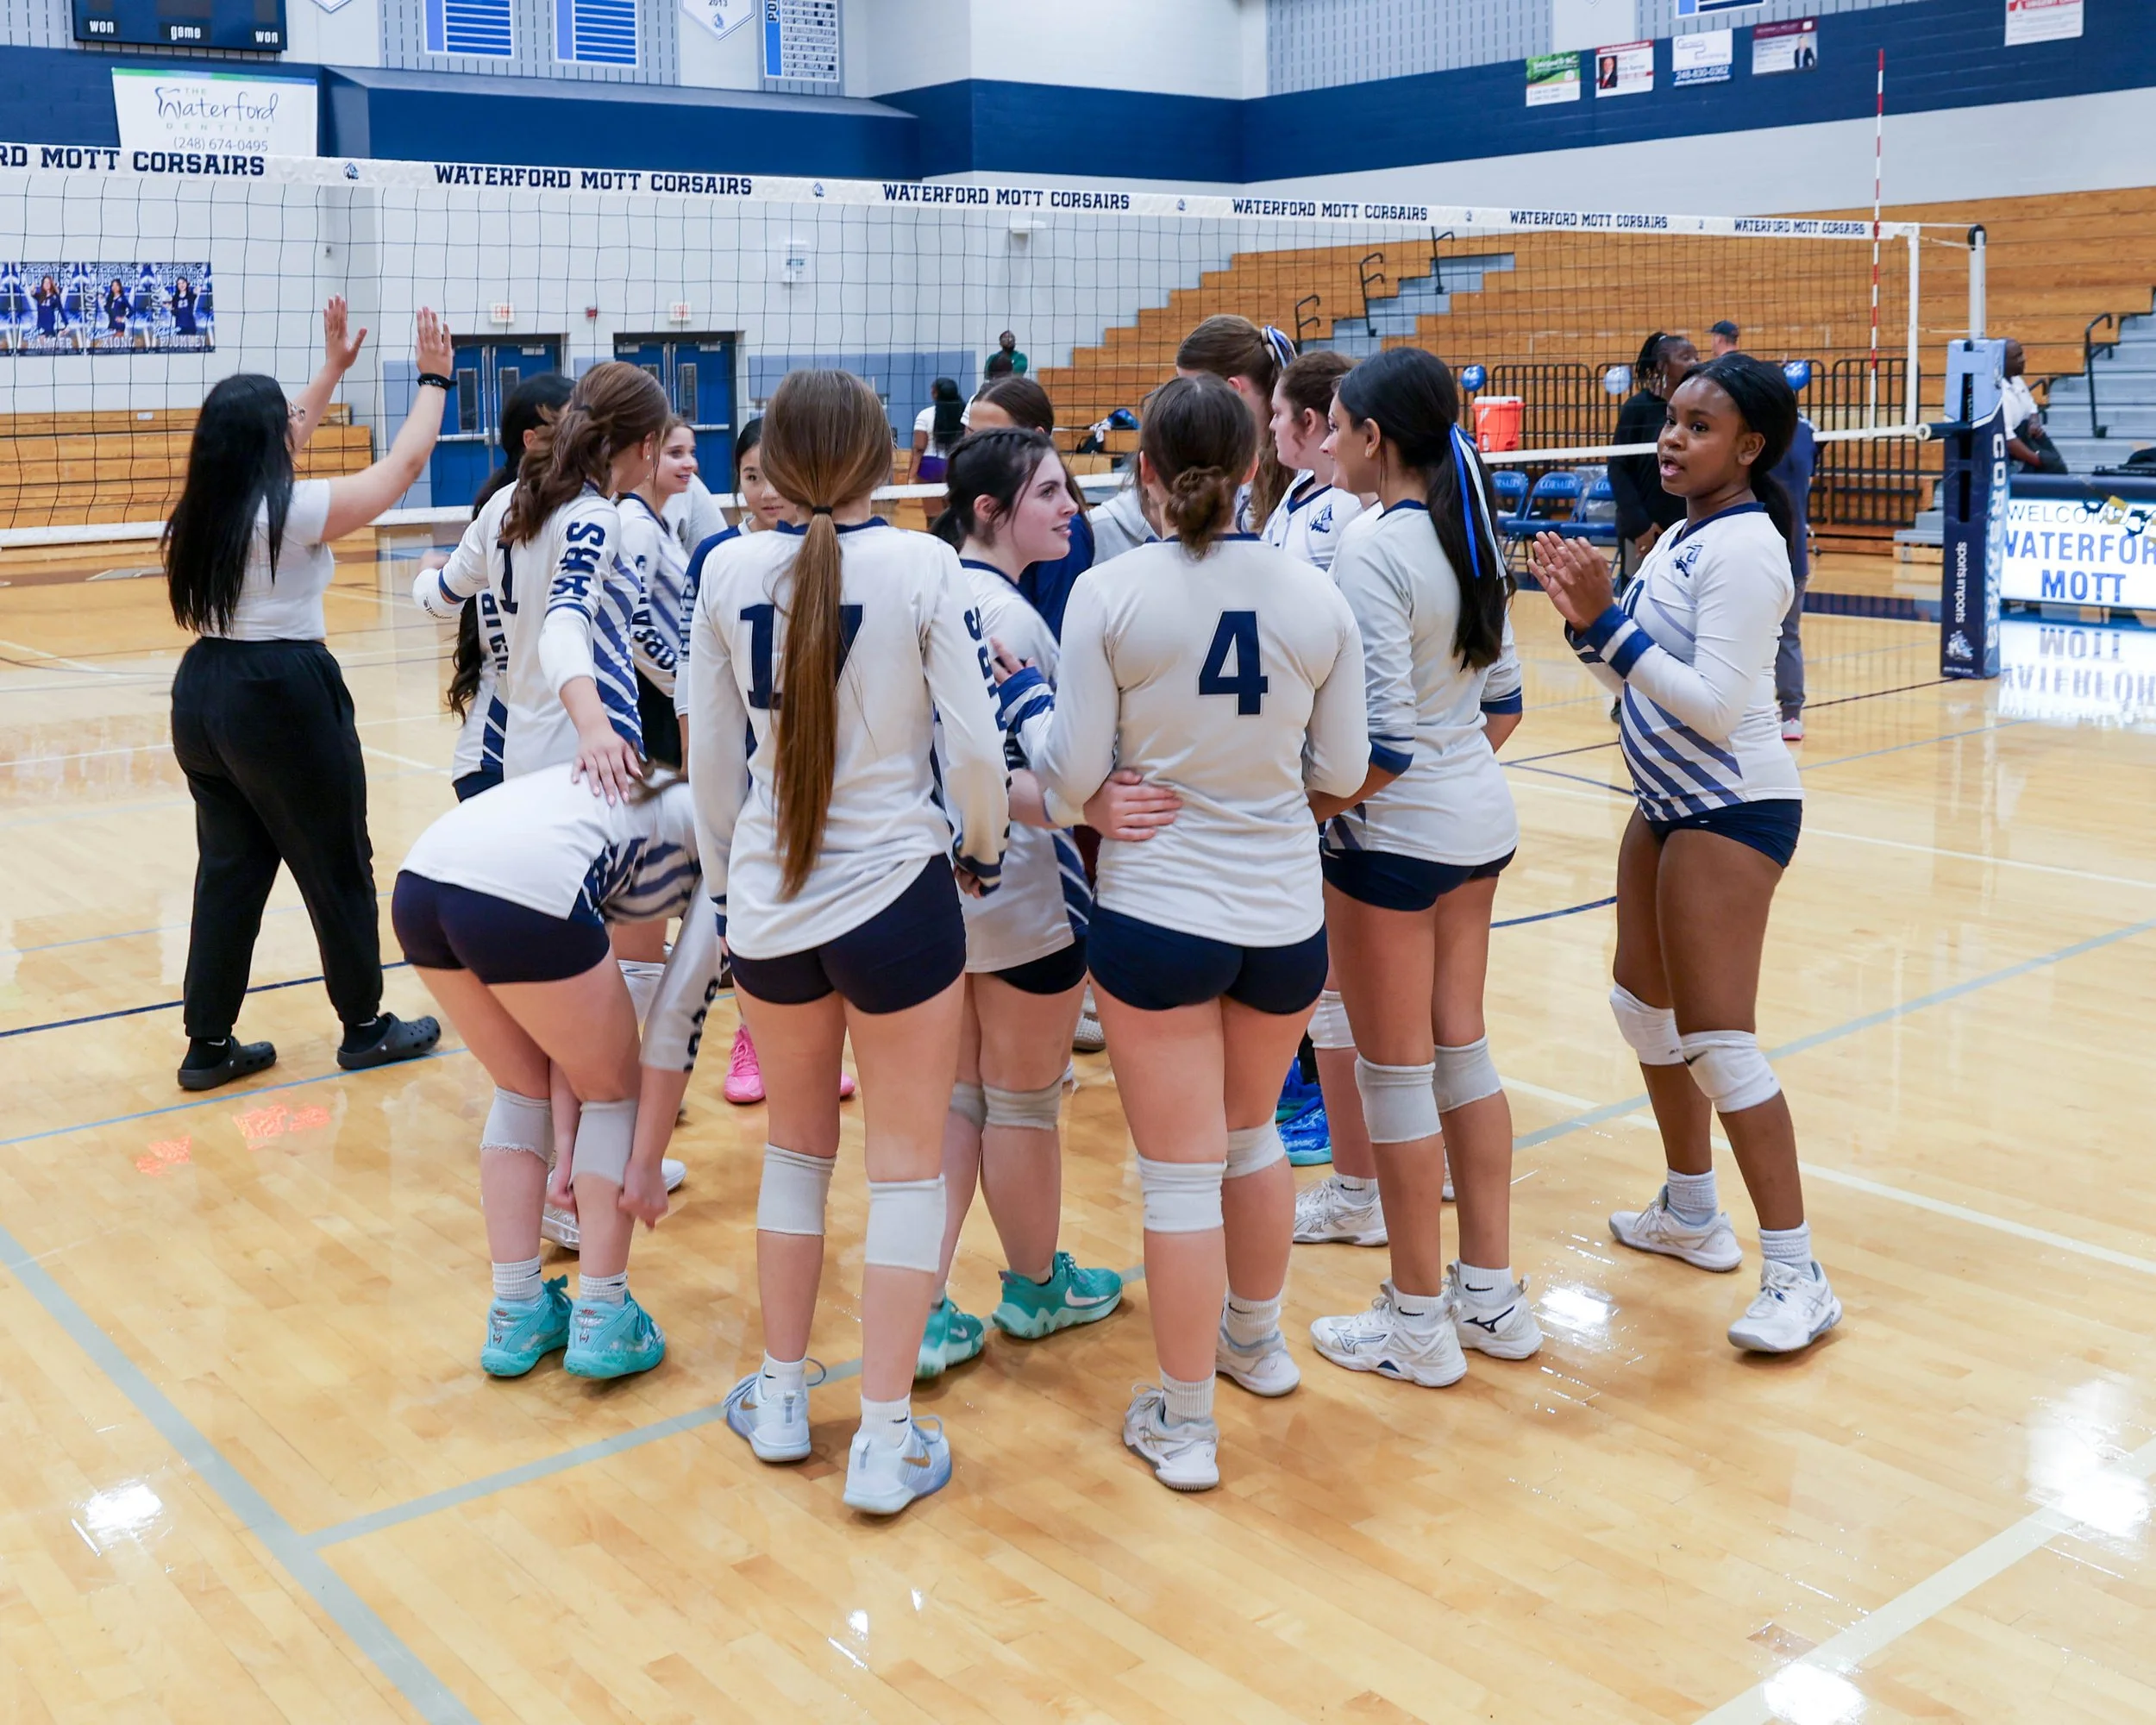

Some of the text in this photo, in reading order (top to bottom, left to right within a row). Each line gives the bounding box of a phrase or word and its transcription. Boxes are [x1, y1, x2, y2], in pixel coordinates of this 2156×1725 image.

[89, 20, 115, 34] won
[170, 25, 201, 41] game
[255, 30, 279, 44] won
[185, 87, 207, 96] THE
[154, 86, 279, 123] Waterford
[166, 122, 270, 134] DENTIST
[173, 136, 269, 152] (248) 674-0495
[41, 147, 120, 170] MOTT
[133, 150, 265, 176] CORSAIRS
[435, 164, 752, 195] WATERFORD MOTT CORSAIRS
[882, 184, 1130, 209] WATERFORD MOTT CORSAIRS
[1232, 198, 1427, 221] WATERFORD MOTT CORSAIRS
[1509, 210, 1668, 229] WATERFORD MOTT CORSAIRS
[1734, 218, 1865, 235] WATERFORD MOTT CORSAIRS
[1986, 432, 2007, 649] CORSAIRS
[1954, 541, 1968, 624] sports imports
[2040, 569, 2127, 602] MOTT
[1198, 609, 1269, 717] 4
